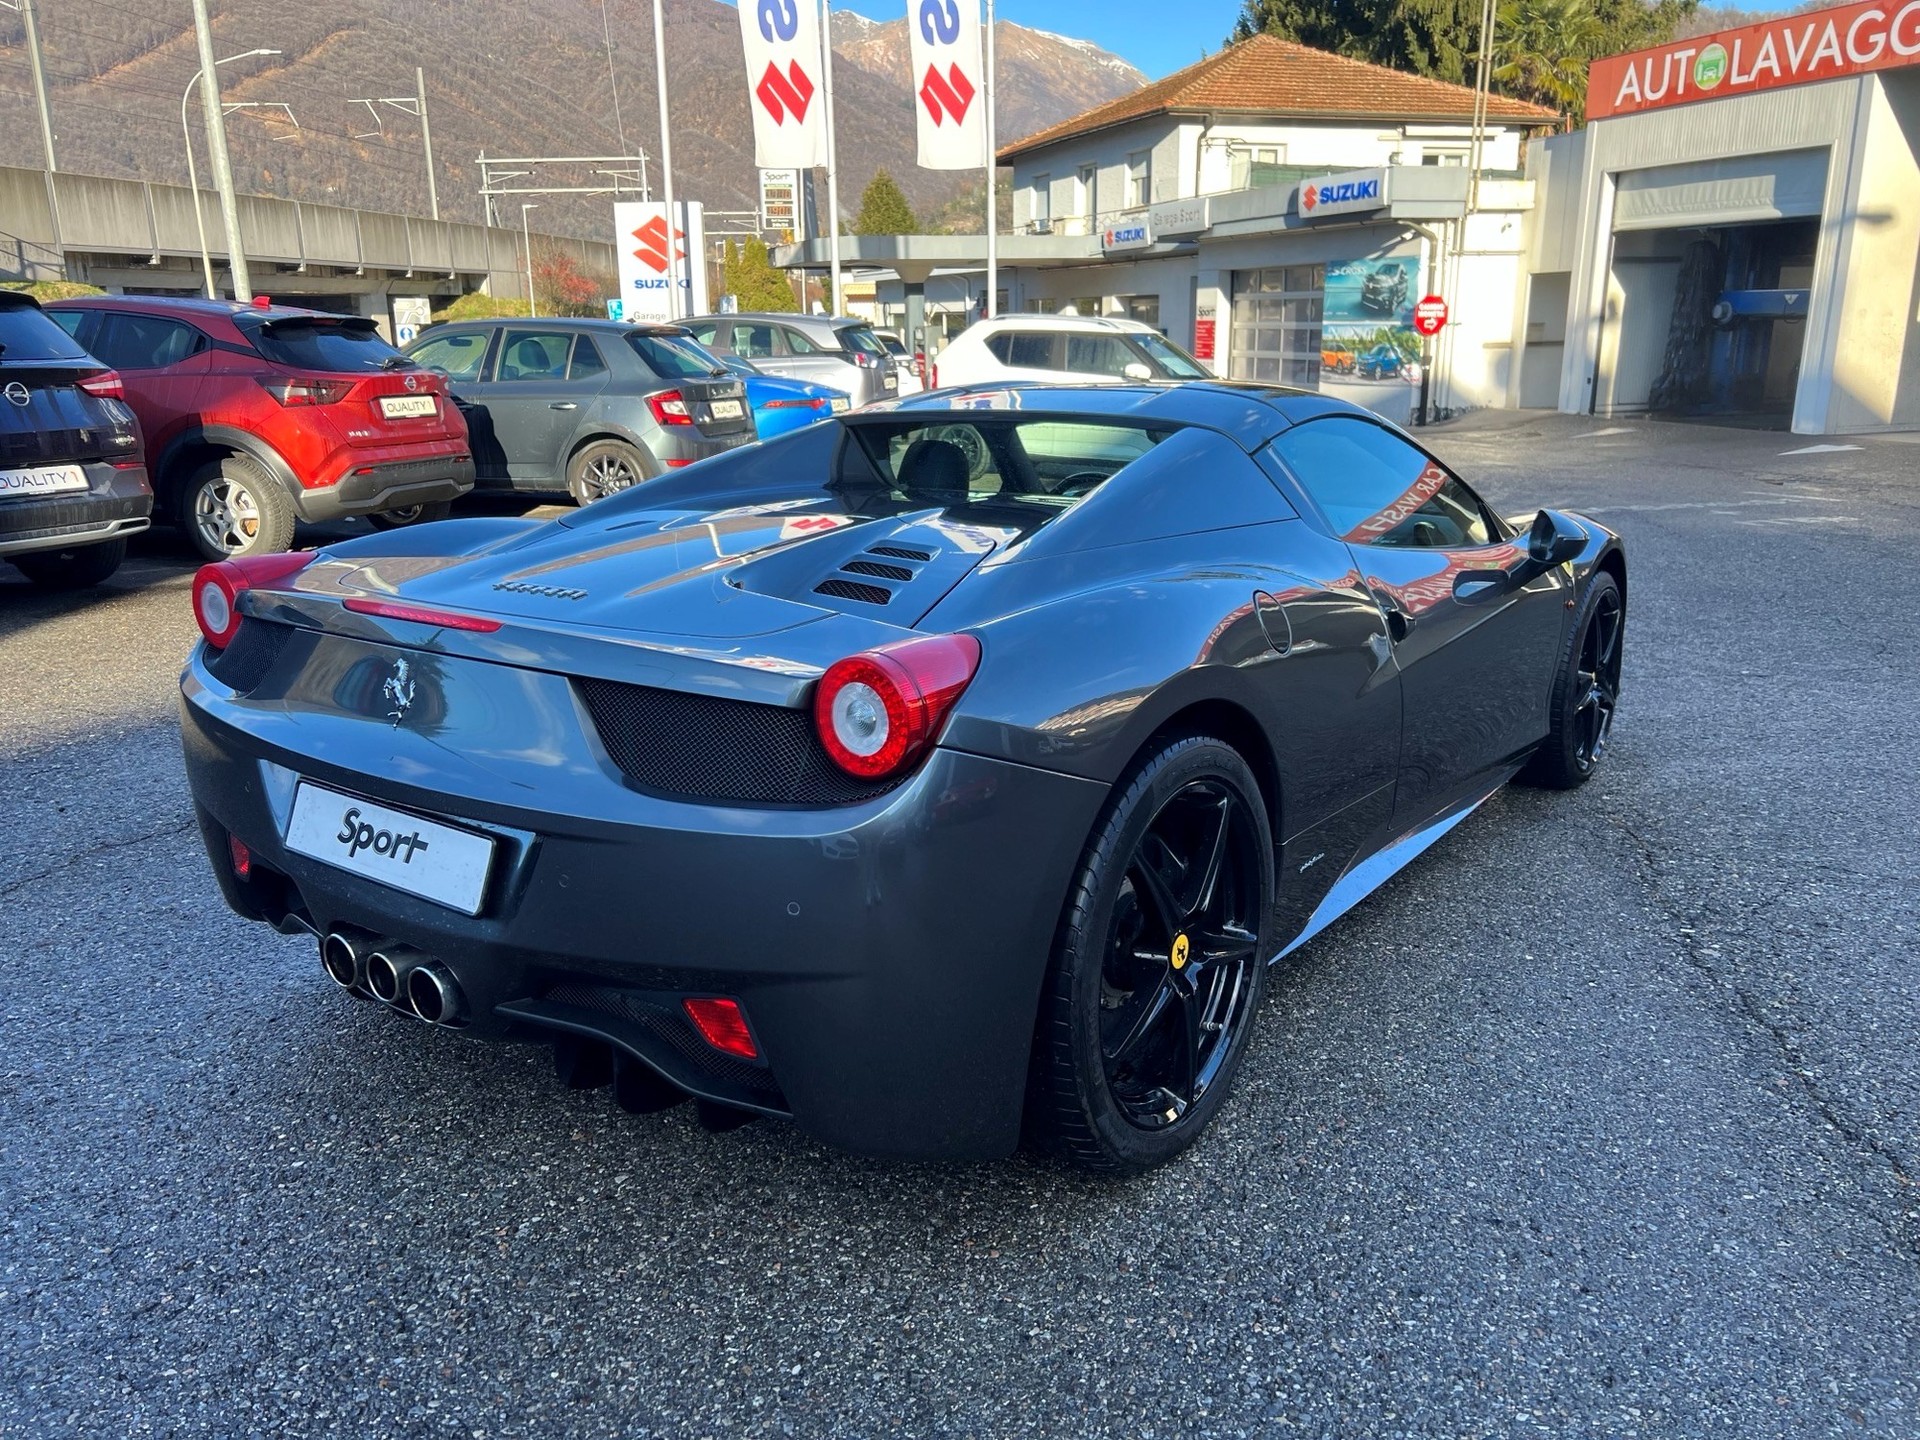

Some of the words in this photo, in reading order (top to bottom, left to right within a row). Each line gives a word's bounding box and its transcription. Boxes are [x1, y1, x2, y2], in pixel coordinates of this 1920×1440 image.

[765, 171, 790, 182] Sport
[1319, 179, 1378, 204] SUZUKI
[1114, 228, 1145, 243] SUZUKI
[633, 311, 667, 321] Garage
[336, 807, 429, 865] Sport
